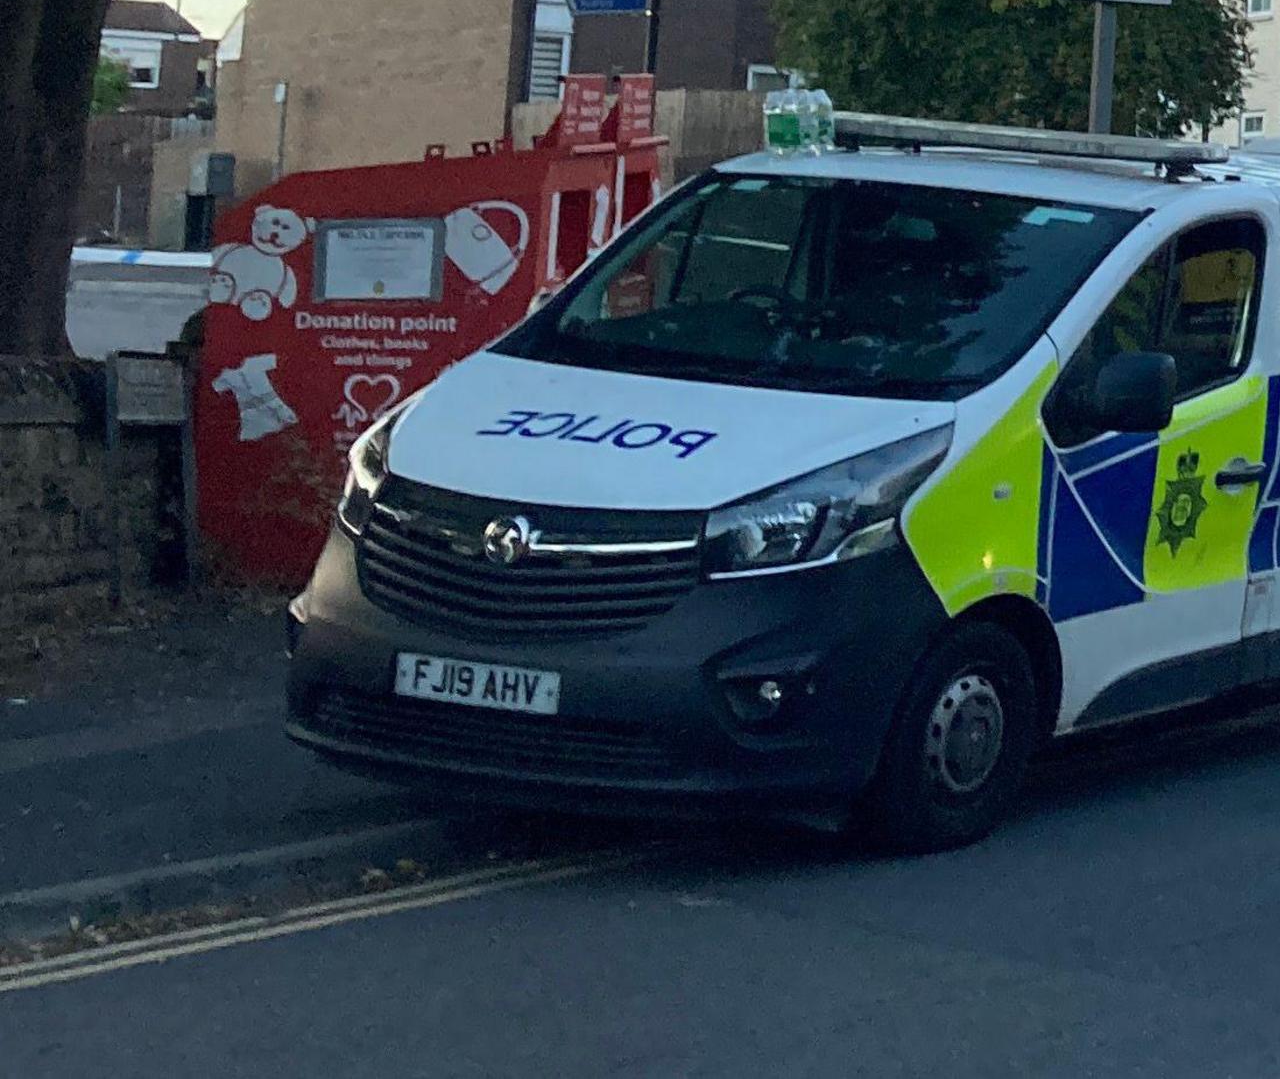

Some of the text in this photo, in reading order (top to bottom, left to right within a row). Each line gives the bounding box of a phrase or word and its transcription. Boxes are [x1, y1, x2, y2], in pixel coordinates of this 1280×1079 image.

[295, 311, 457, 335] Donation point
[321, 334, 429, 351] Clothes, books
[333, 352, 412, 370] and things
[414, 659, 540, 705] FJ19 AHV
